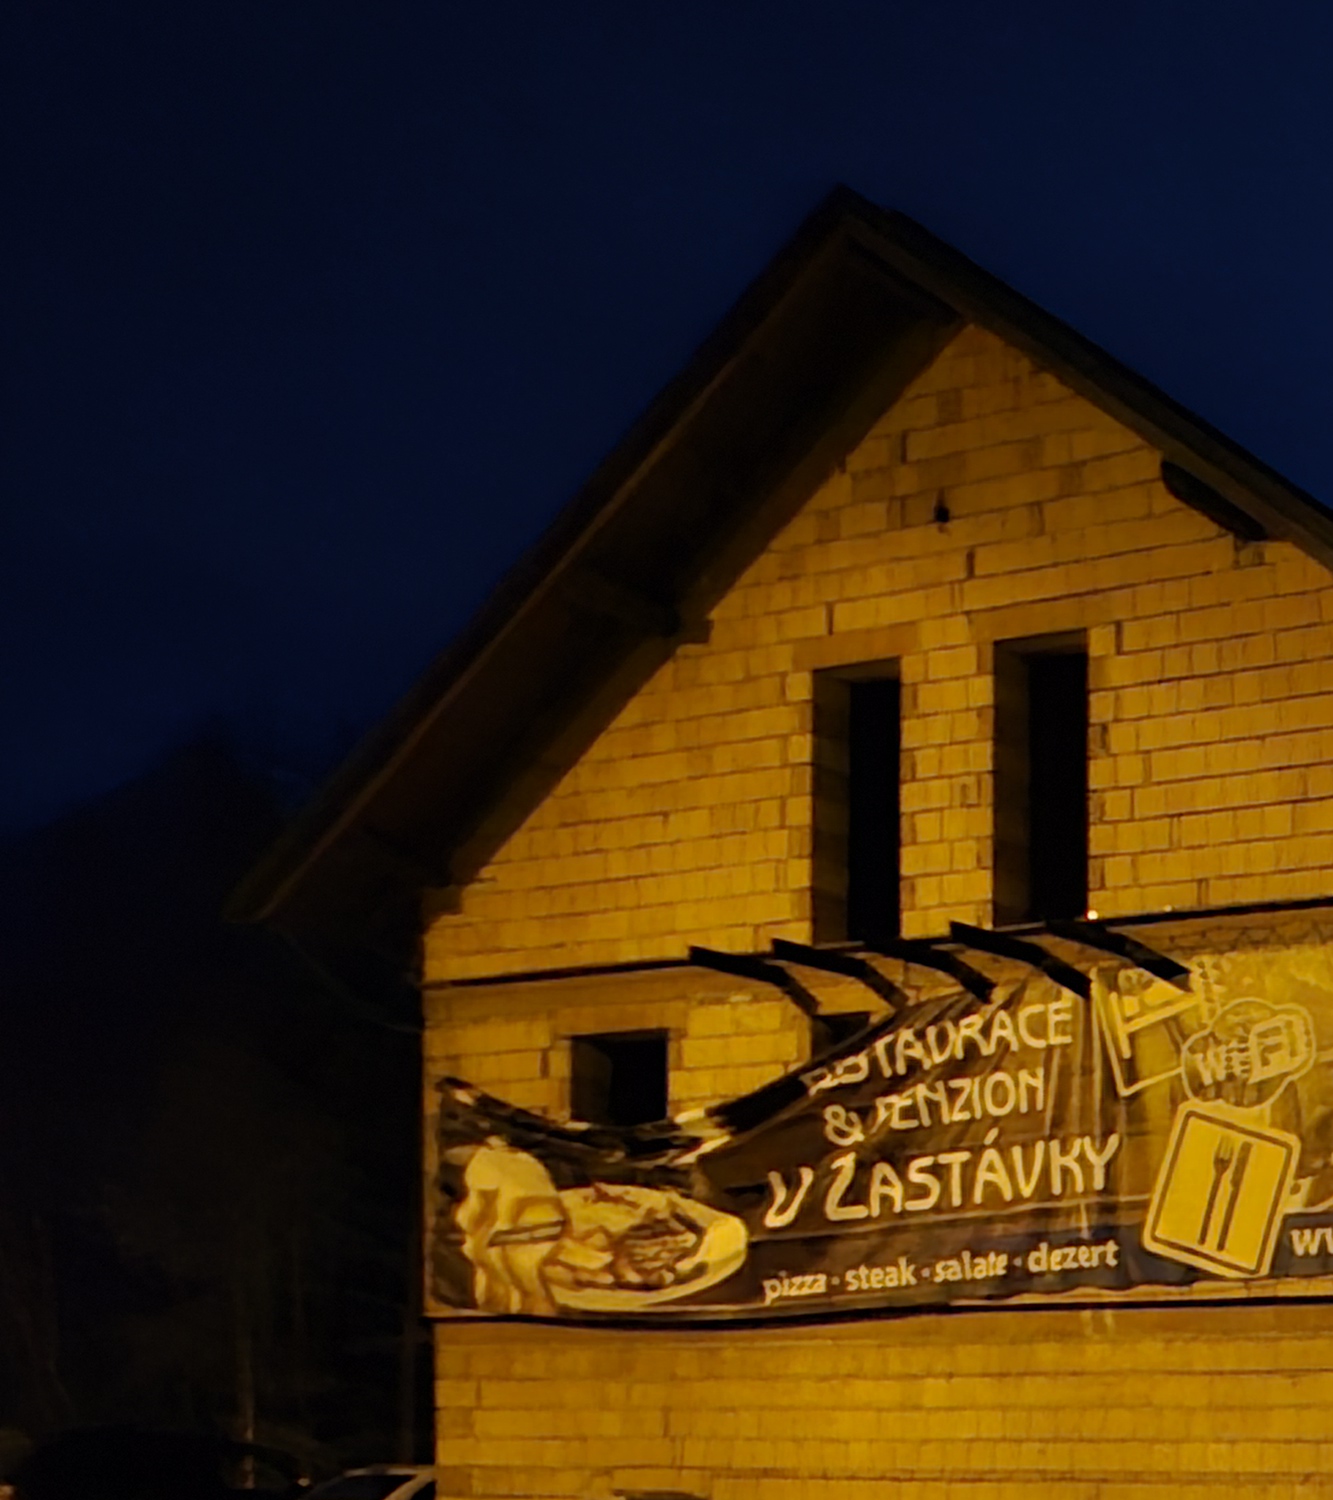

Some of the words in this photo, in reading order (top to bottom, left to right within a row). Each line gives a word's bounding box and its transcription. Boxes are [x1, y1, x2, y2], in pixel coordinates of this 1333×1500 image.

[823, 1104, 865, 1146] &
[825, 1127, 1120, 1222] ZASTÁVKY
[763, 1269, 828, 1306] pizza
[845, 1256, 918, 1292] steak
[1027, 1239, 1121, 1273] dezert
